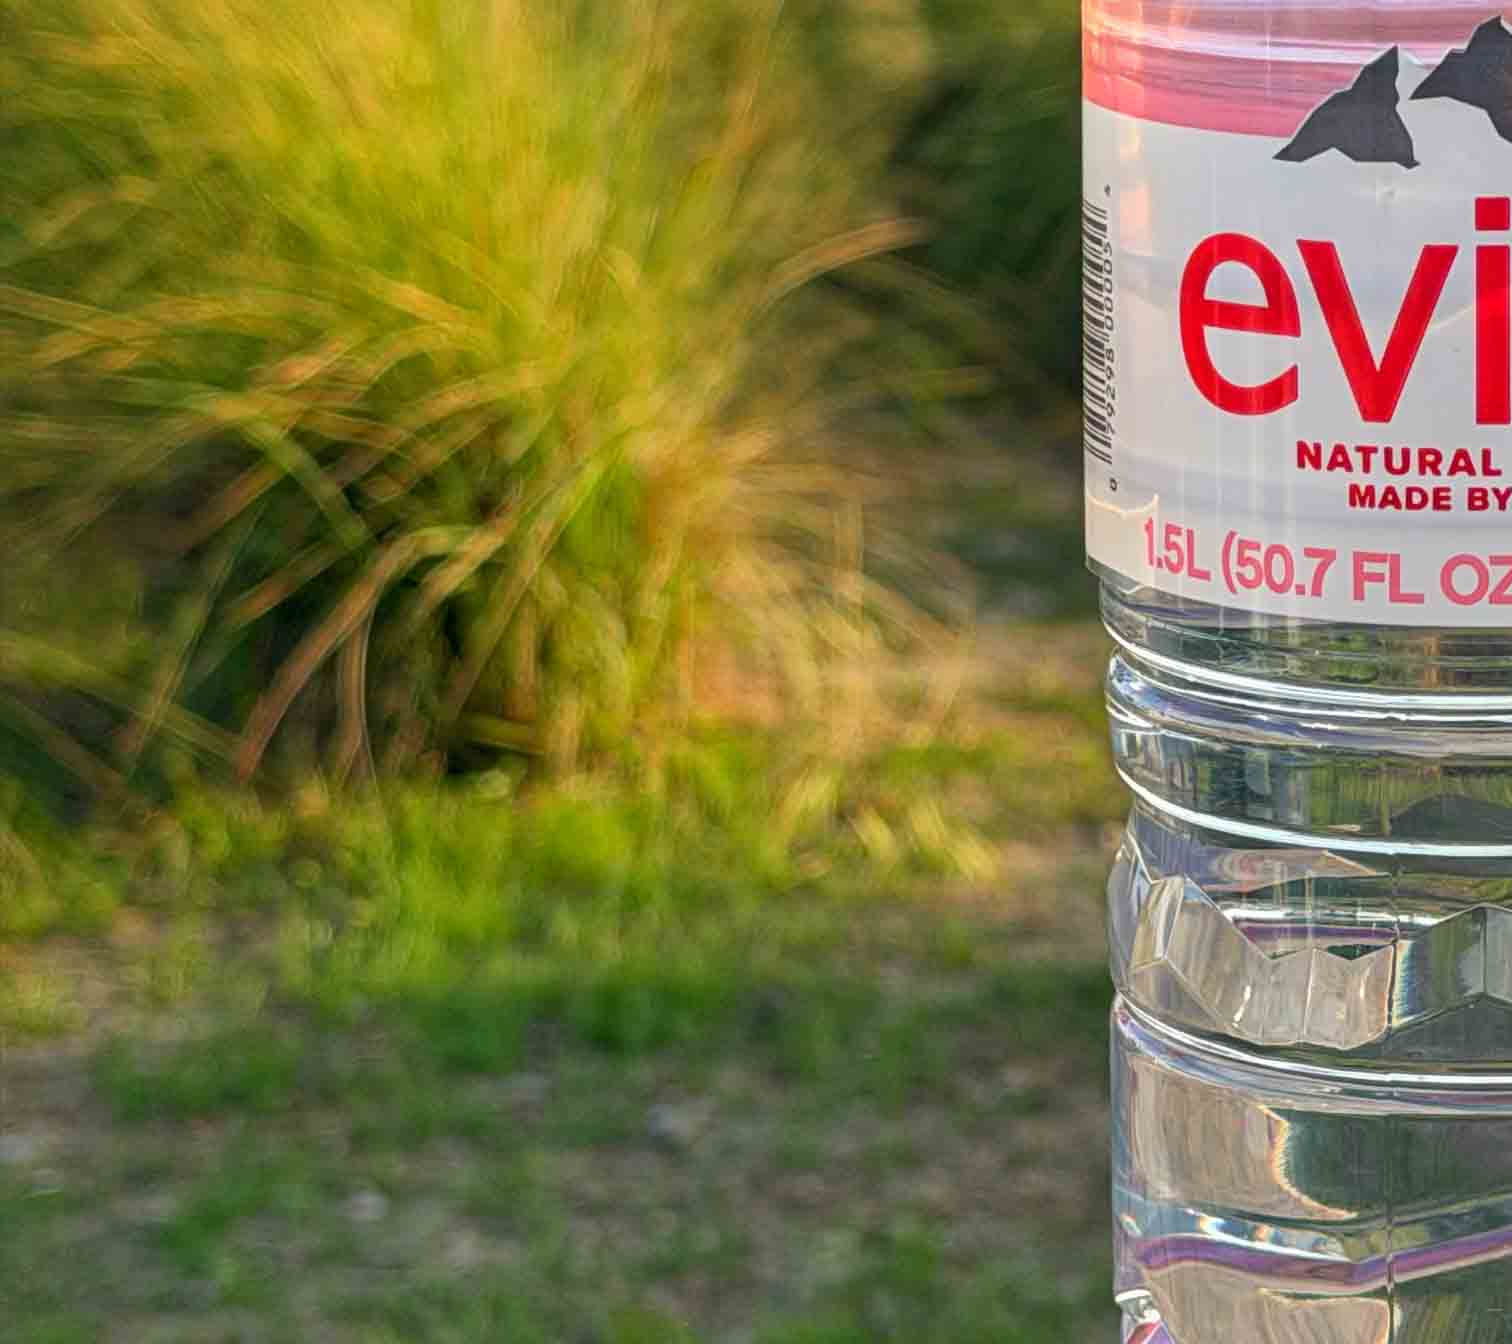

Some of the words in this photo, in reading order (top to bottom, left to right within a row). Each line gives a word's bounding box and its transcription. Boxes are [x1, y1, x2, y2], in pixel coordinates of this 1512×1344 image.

[1296, 440, 1503, 479] NATURAL
[1347, 481, 1453, 512] MADE
[1143, 516, 1212, 583] 1.5L
[1221, 530, 1338, 597] (50.7
[1351, 550, 1425, 605] FL
